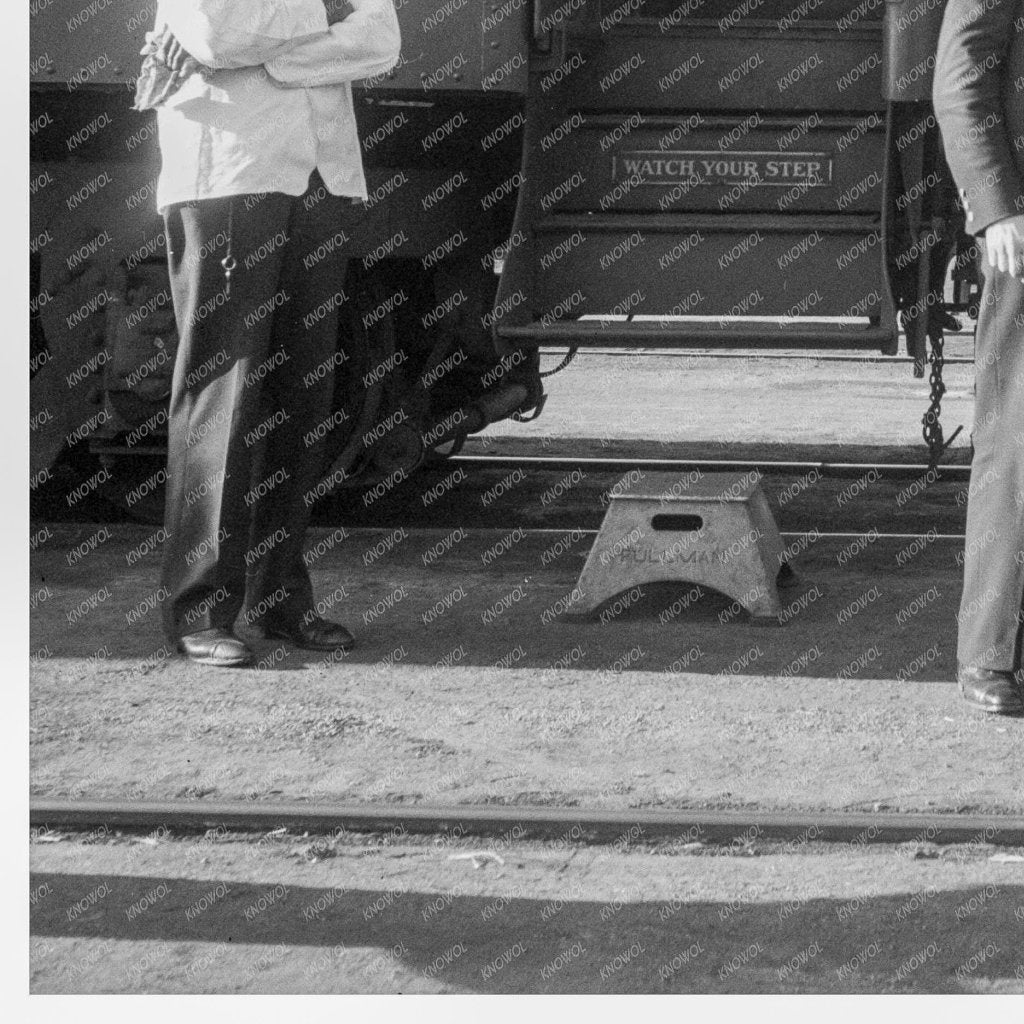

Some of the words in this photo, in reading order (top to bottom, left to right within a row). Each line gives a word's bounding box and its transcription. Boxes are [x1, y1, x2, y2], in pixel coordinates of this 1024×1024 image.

[623, 159, 693, 176] WATCH
[702, 160, 758, 177] YOUR
[765, 161, 821, 177] STEP
